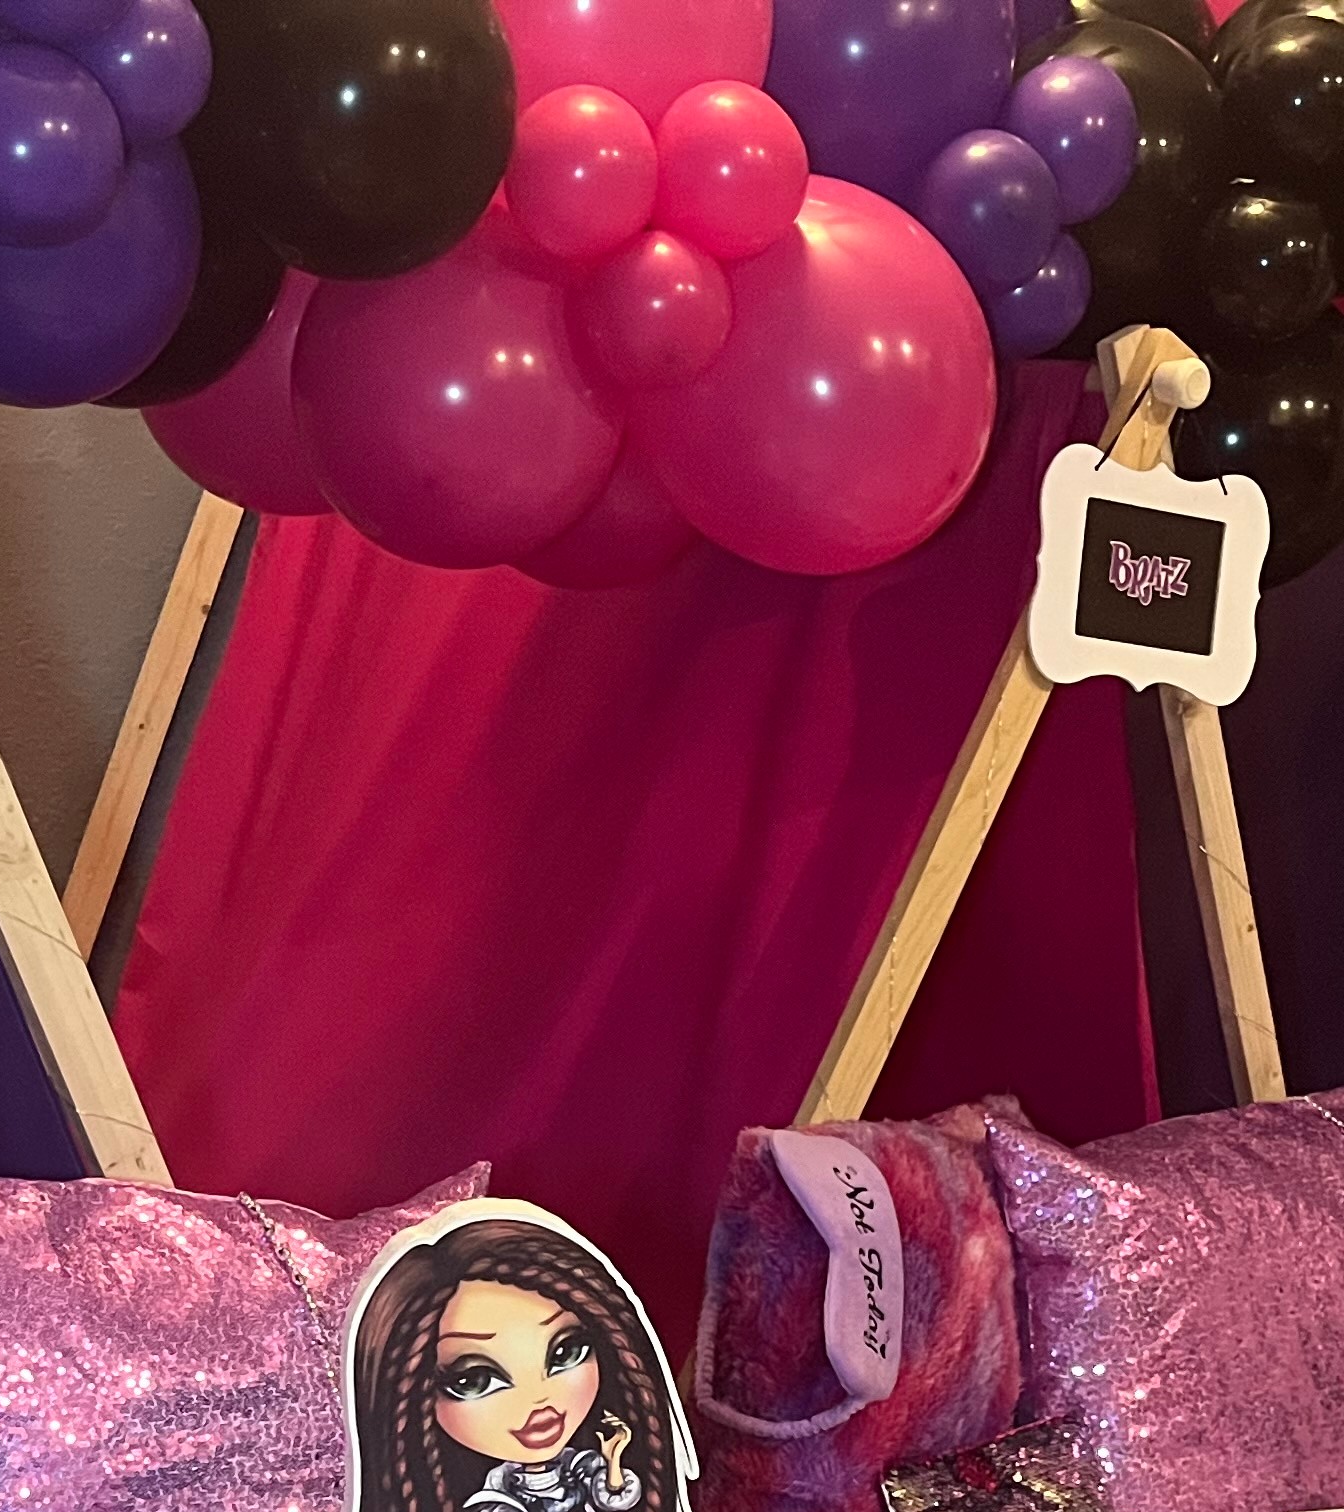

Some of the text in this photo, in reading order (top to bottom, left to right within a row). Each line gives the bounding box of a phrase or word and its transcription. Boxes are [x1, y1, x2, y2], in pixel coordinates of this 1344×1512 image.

[1109, 541, 1191, 606] BRATZ
[832, 1166, 885, 1354] Not Today
